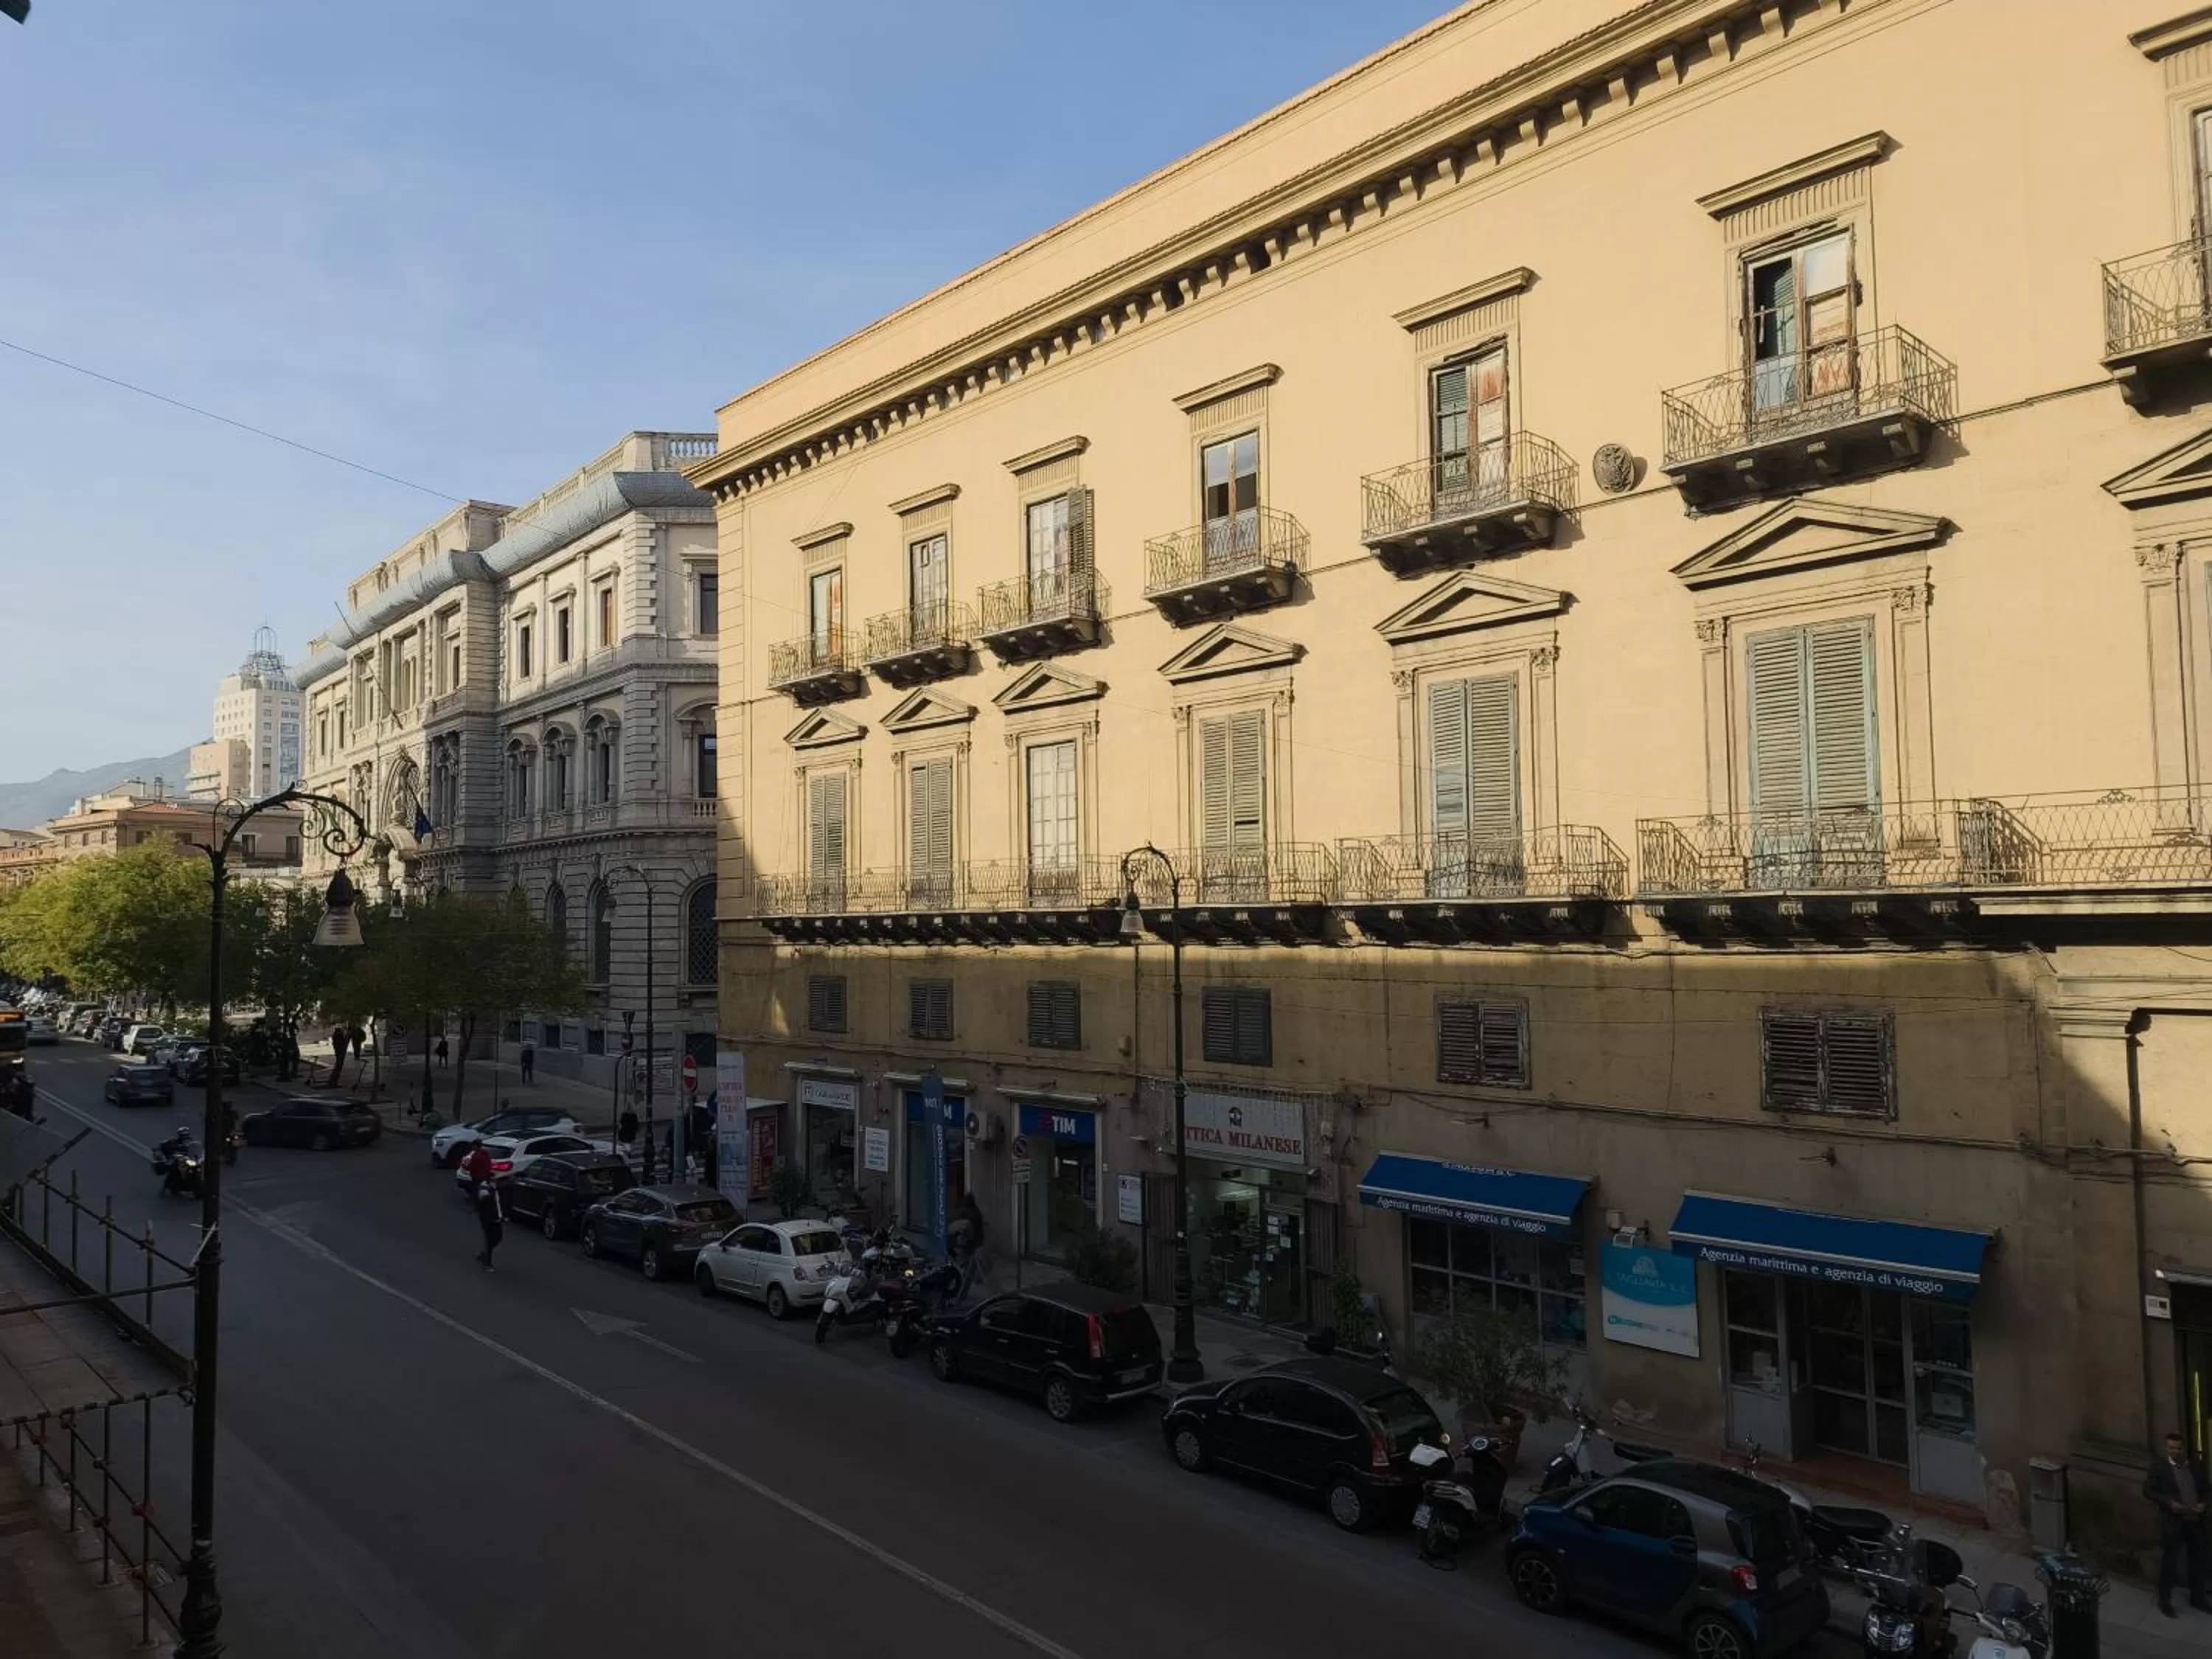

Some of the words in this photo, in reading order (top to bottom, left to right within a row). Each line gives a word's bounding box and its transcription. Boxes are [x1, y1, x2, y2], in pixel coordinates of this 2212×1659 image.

[1051, 1115, 1077, 1135] TIM
[1186, 1126, 1224, 1144] TTICA
[1228, 1130, 1301, 1155] MILANESE
[1377, 1195, 1410, 1210] Agenzia
[1412, 1202, 1453, 1217] marittima
[1455, 1211, 1462, 1219] e
[1464, 1211, 1499, 1225] agenzia
[1500, 1215, 1511, 1226] di
[1512, 1219, 1547, 1234] viaggio
[1699, 1245, 1746, 1265] Agenzia
[1748, 1255, 1807, 1274] marittima
[1810, 1266, 1819, 1276] e
[1824, 1267, 1874, 1285] agenzia
[1878, 1273, 1892, 1286] di
[1894, 1276, 1944, 1295] viaggio
